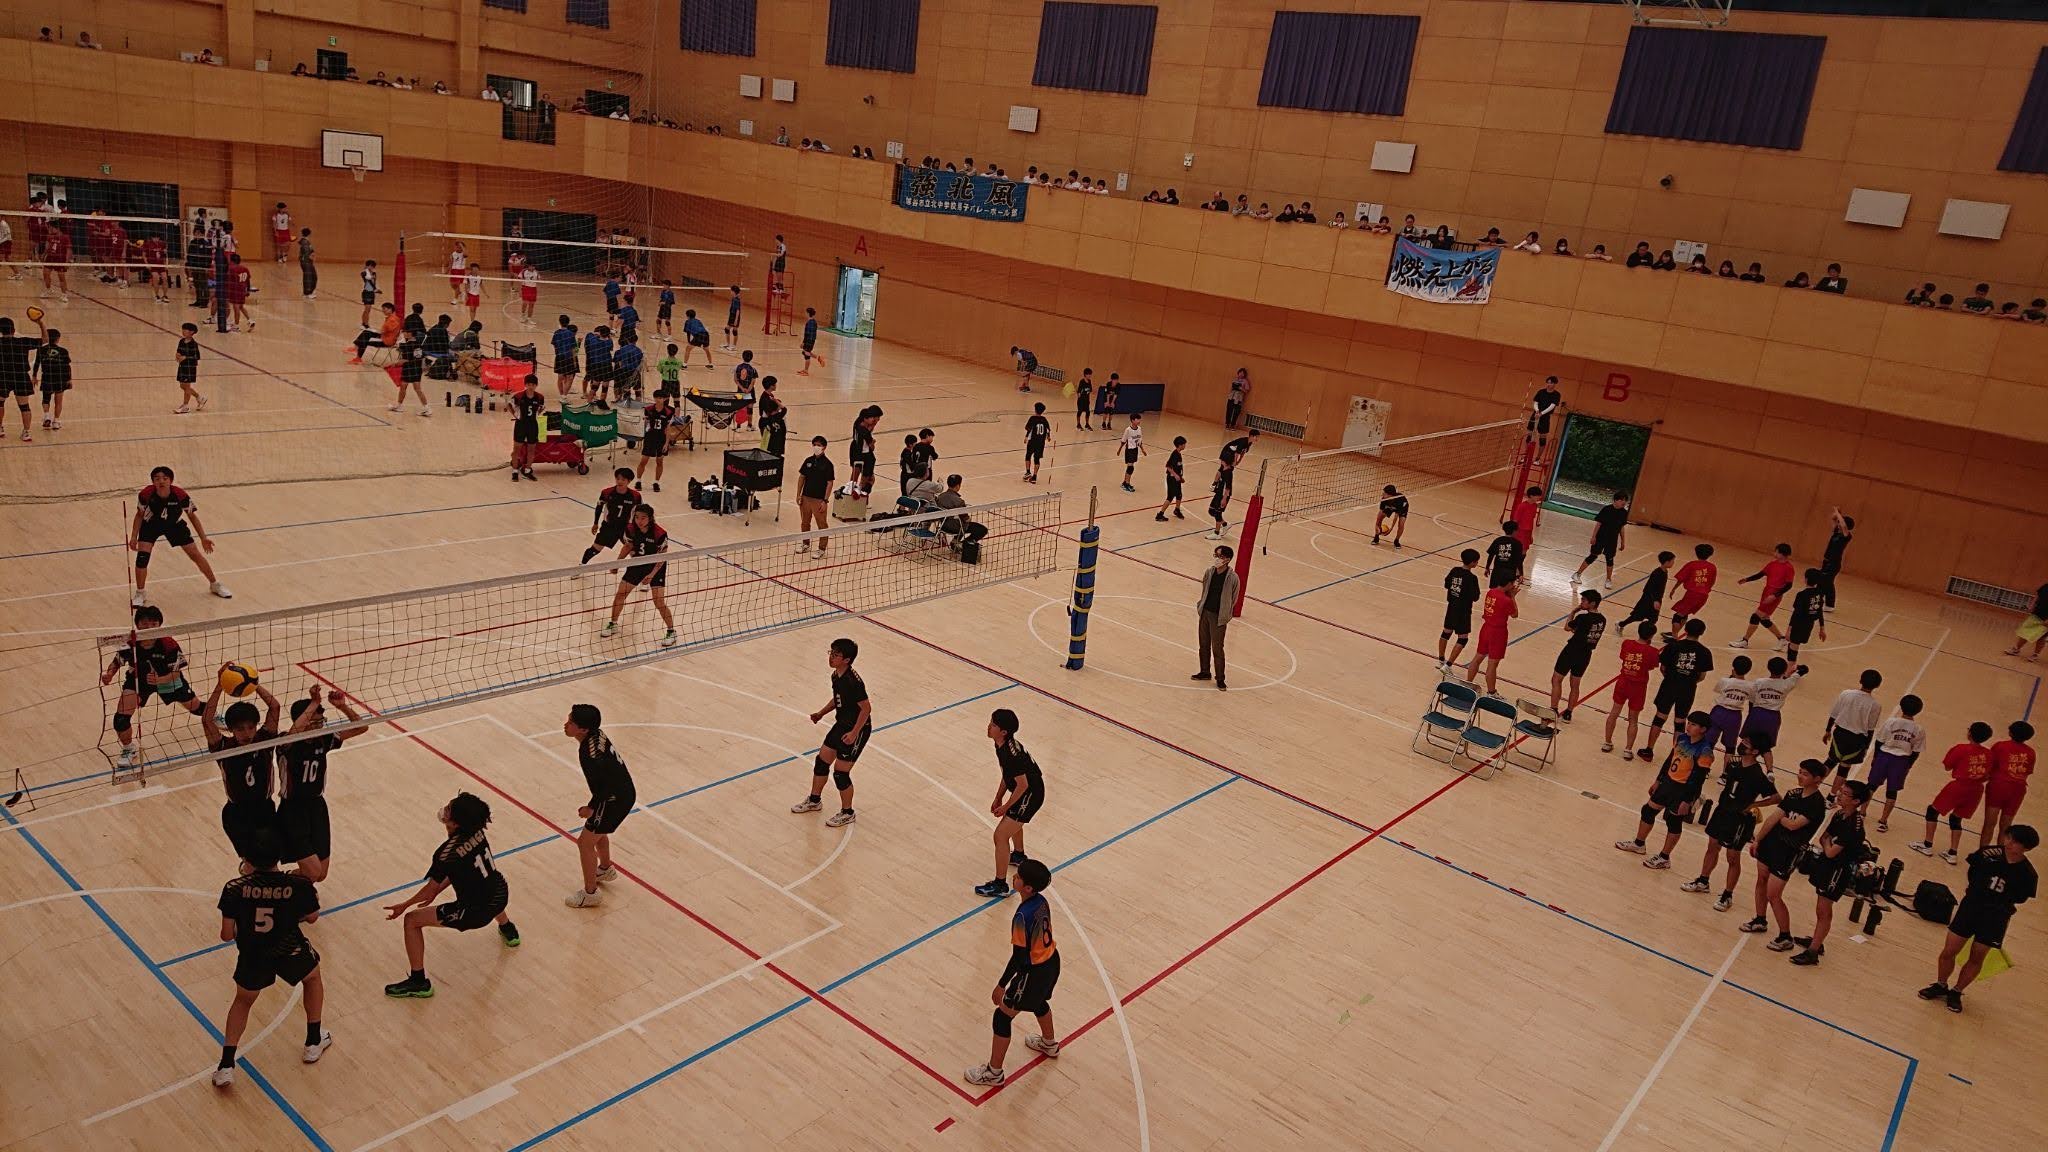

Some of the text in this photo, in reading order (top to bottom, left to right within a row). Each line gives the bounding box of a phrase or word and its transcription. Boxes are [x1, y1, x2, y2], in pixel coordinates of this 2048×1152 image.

[855, 235, 868, 256] A
[1391, 252, 1493, 289] 燃え上がる
[666, 369, 678, 380] 10
[1604, 372, 1631, 402] B
[527, 405, 533, 417] 5
[589, 424, 613, 432] molten
[1036, 423, 1044, 435] 10
[161, 507, 168, 520] 4
[617, 504, 624, 518] 7
[638, 542, 646, 555] 3
[302, 760, 319, 783] 10
[1671, 758, 1681, 773] 6
[245, 765, 255, 787] 6
[456, 829, 485, 858] HONG
[474, 846, 496, 879] 11
[242, 886, 293, 899] HONGO
[1990, 875, 2006, 893] 15
[254, 907, 275, 934] 5
[1043, 917, 1053, 948] 8
